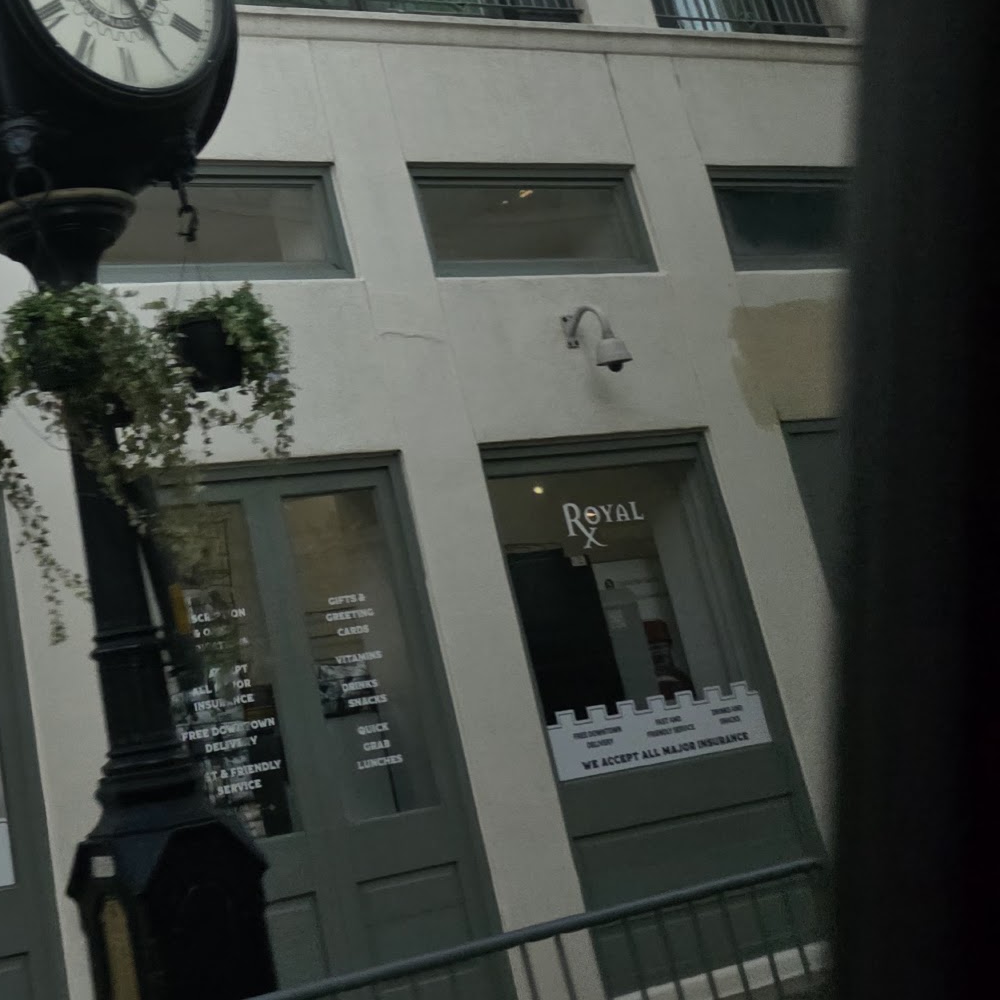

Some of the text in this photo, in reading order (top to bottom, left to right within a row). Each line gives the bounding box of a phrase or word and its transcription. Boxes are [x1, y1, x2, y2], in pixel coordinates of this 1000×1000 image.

[562, 500, 645, 538] ROYAL
[328, 594, 358, 606] GIFTS
[325, 608, 375, 622] GREETING
[336, 624, 370, 637] CARDS
[335, 650, 383, 665] VITAMINS
[341, 679, 379, 692] DRINKS
[348, 694, 388, 708] SNACKS
[181, 728, 209, 742] FREE
[356, 722, 389, 735] QUICK
[362, 738, 391, 751] GRAB
[581, 731, 750, 770] WE ACCEPT ALL MAJOR INSURANCE
[357, 754, 403, 770] LUNCHES
[220, 768, 229, 780] &
[230, 759, 282, 778] FRIENDLY
[217, 778, 263, 796] SERVICE
